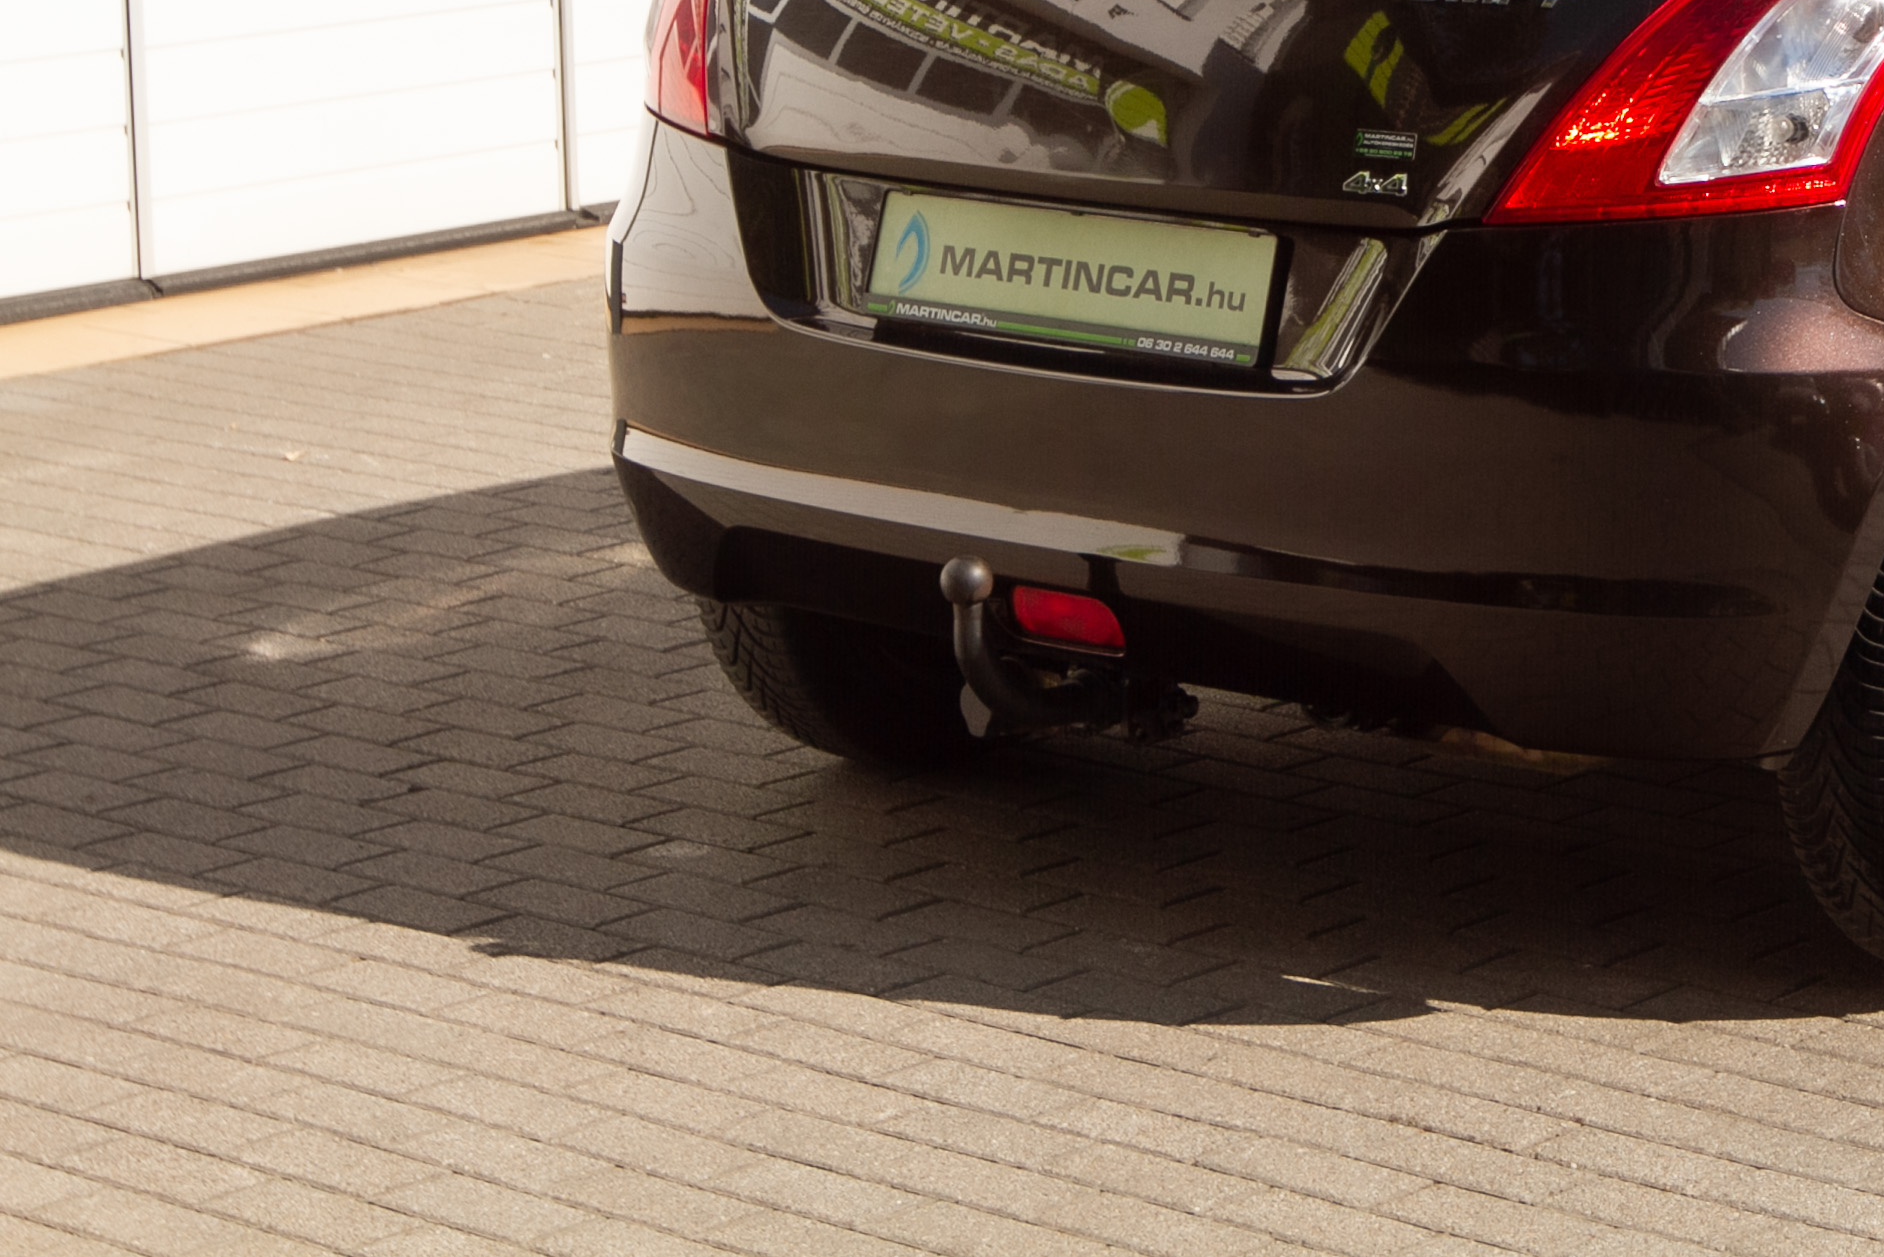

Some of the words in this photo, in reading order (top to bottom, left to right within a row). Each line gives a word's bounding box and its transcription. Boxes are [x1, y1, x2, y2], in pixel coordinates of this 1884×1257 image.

[940, 245, 1246, 312] MARTINCAR.hu
[896, 302, 997, 328] MARTINCAR.hu
[1137, 337, 1154, 349] 06
[1155, 339, 1172, 352] 30
[1173, 342, 1182, 353] 2
[1184, 344, 1208, 356] 644
[1210, 347, 1235, 360] 644
